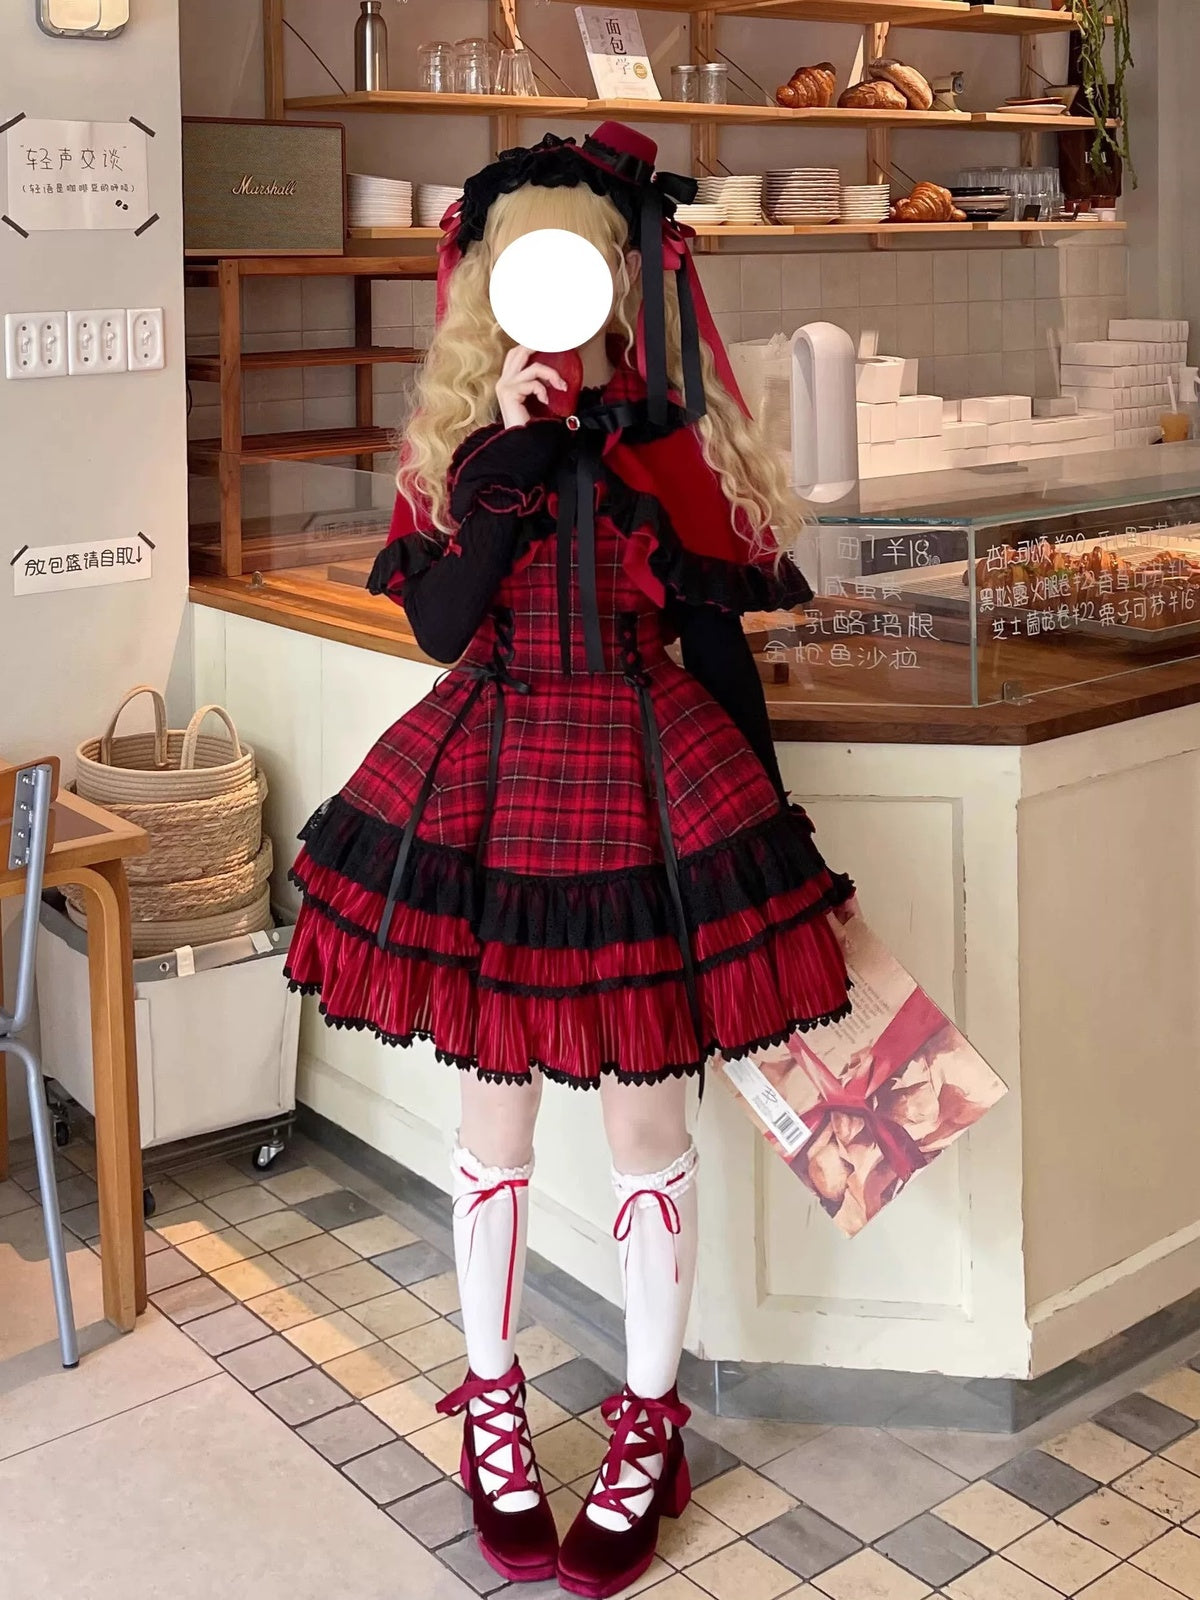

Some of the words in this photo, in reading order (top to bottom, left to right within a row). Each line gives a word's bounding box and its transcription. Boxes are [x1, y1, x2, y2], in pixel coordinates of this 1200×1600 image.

[232, 174, 297, 196] Marshall
[25, 547, 136, 576] 放包篮请自取
[776, 609, 940, 641] 乳酪培根
